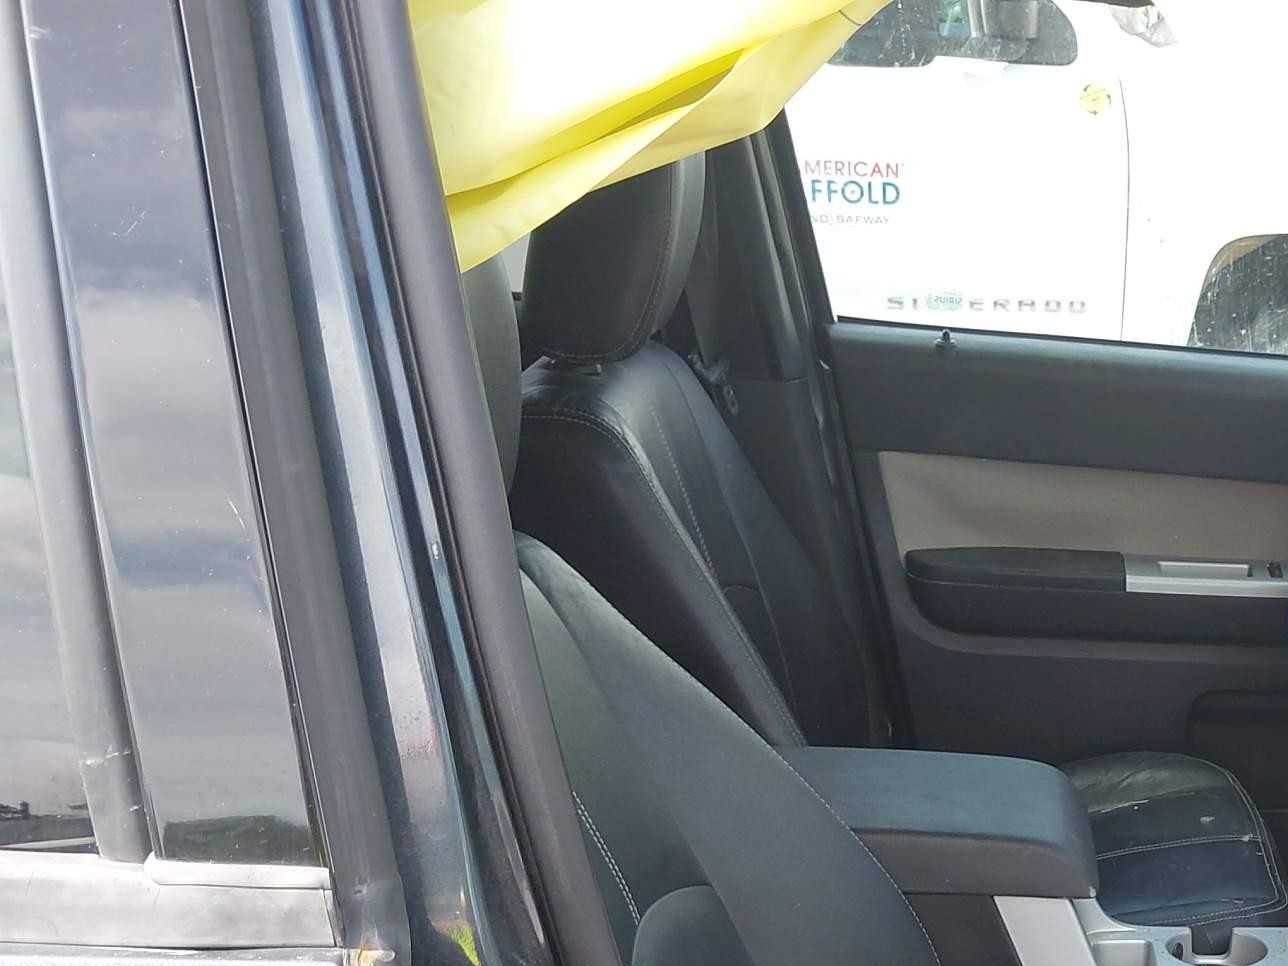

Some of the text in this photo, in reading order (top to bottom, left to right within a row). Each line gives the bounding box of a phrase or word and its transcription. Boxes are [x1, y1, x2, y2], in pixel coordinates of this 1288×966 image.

[804, 159, 900, 178] MERICAN
[810, 179, 900, 204] FFOLD
[886, 296, 1086, 313] SIERADO
